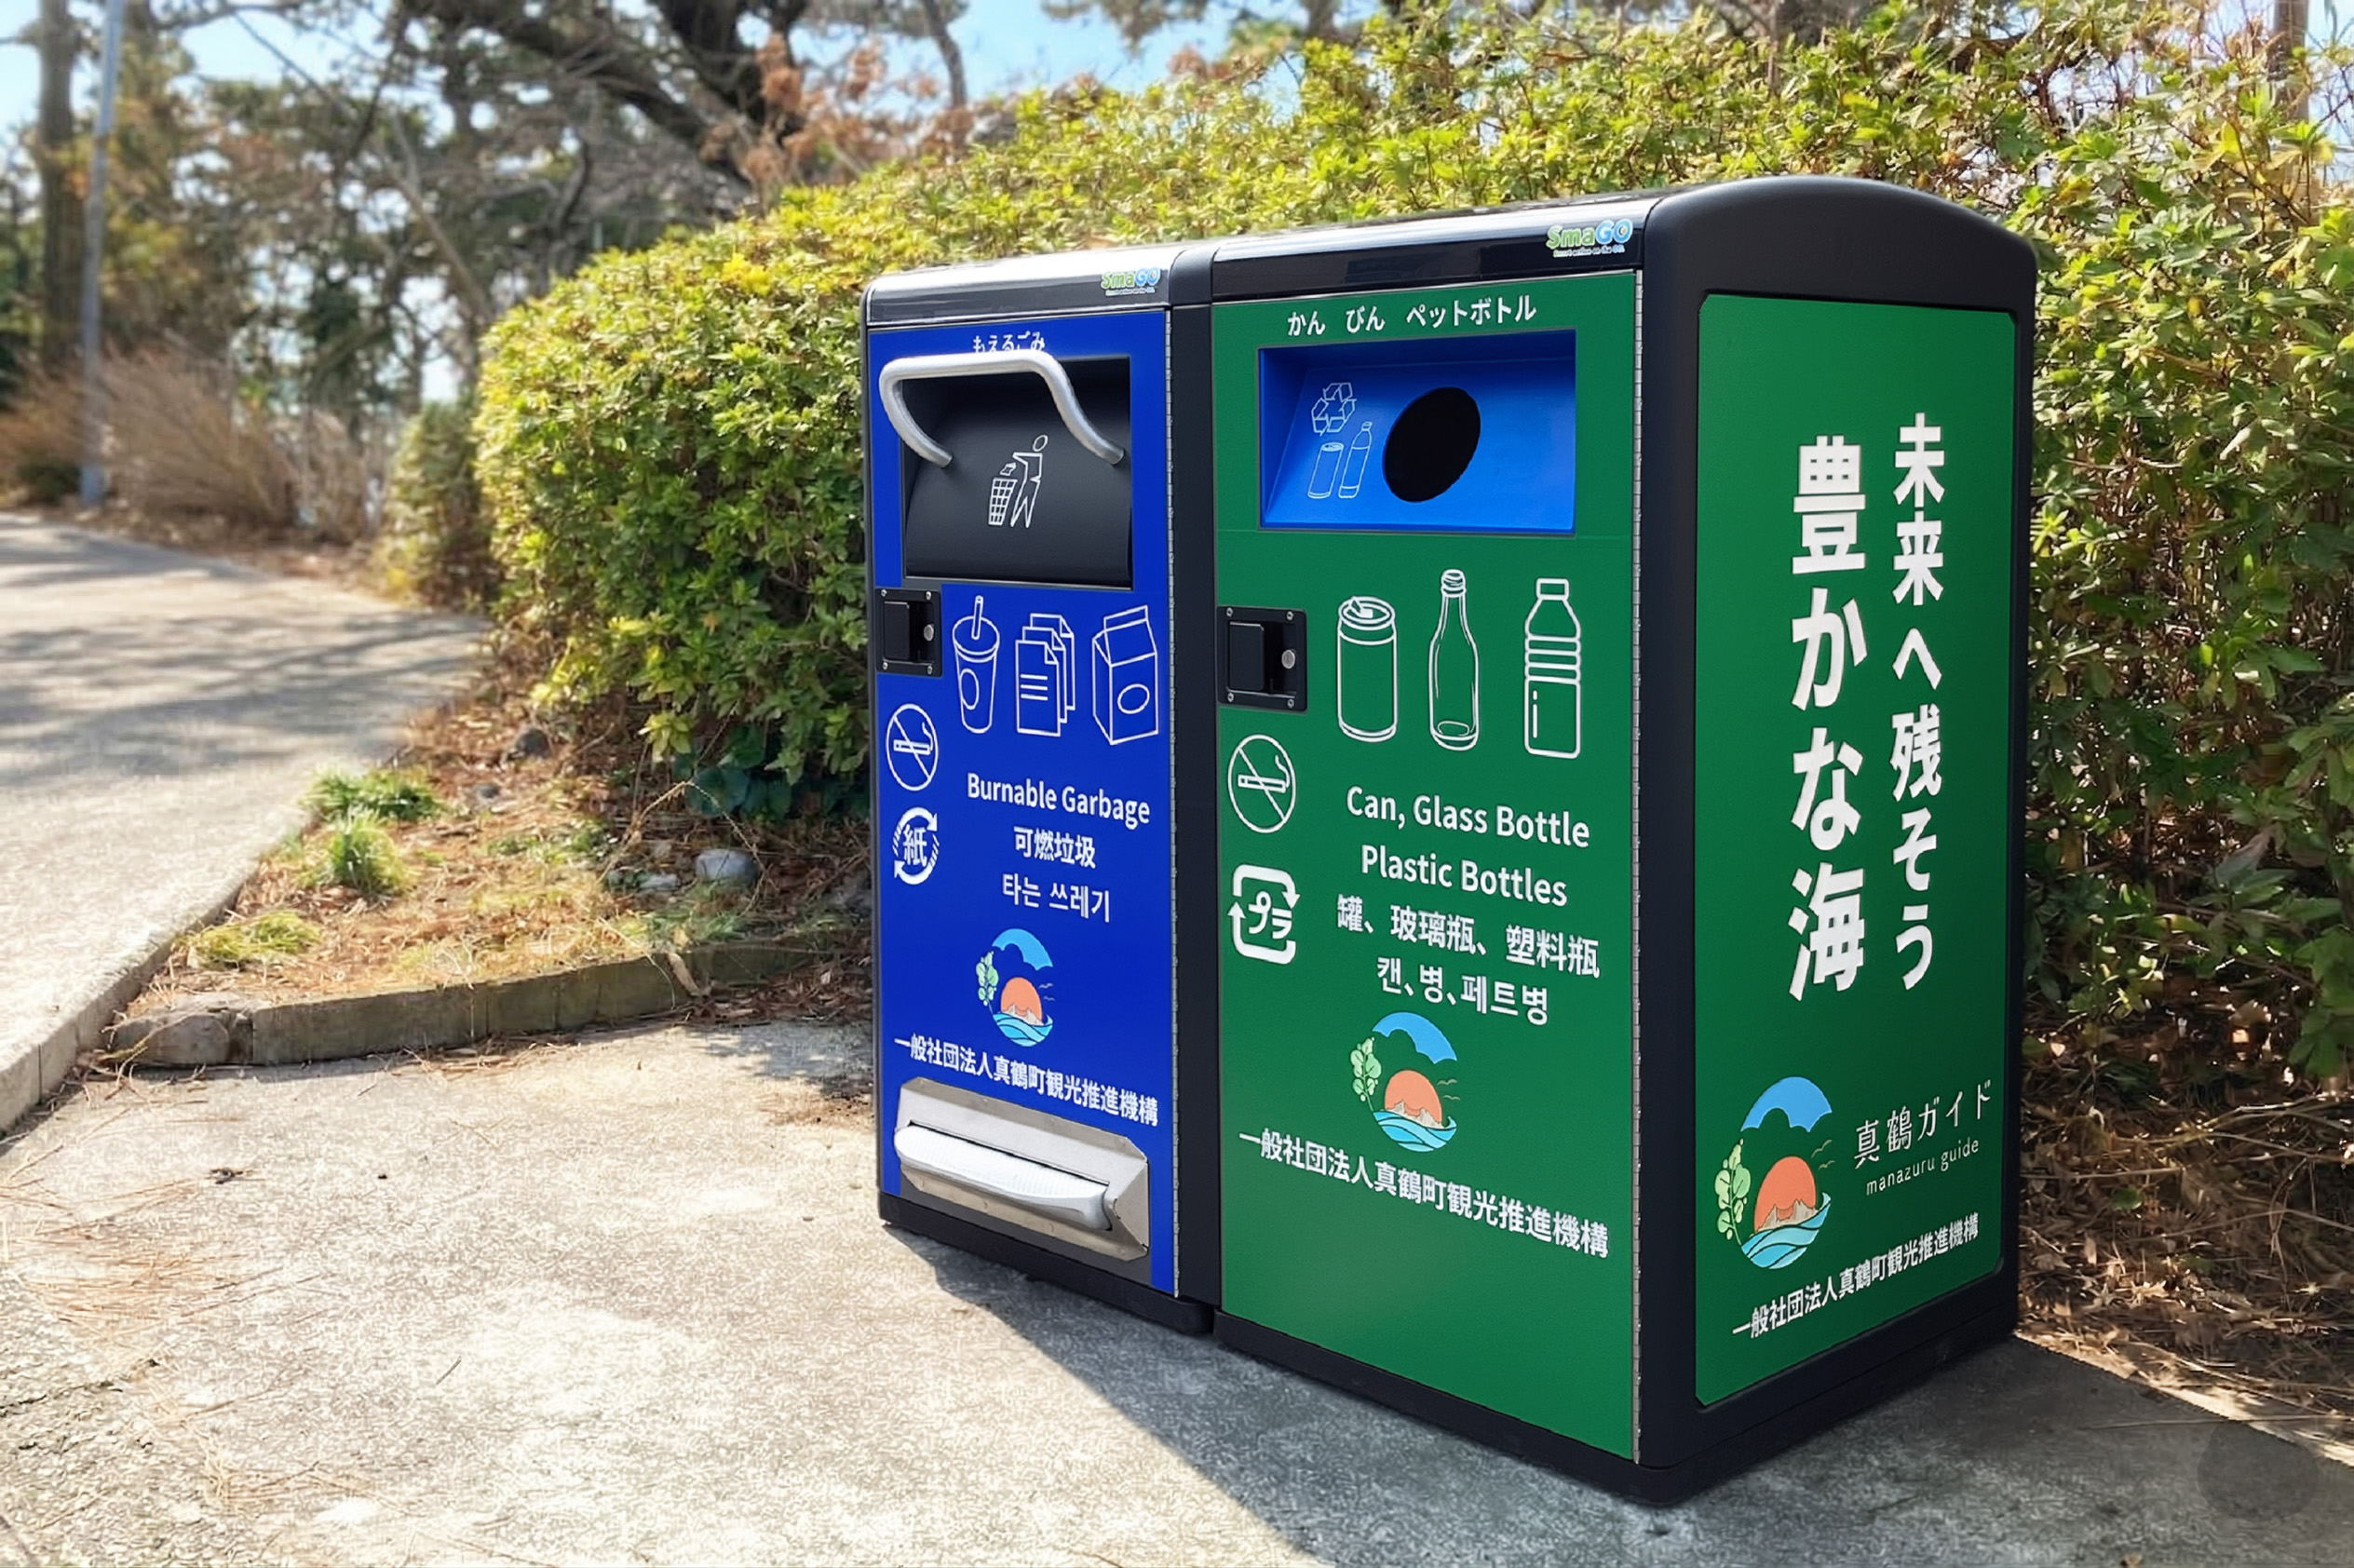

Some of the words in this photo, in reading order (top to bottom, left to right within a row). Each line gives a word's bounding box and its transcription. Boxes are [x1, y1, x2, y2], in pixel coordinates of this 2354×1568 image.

[1546, 218, 1633, 250] SmaGO
[1101, 267, 1161, 291] SmaGO
[1287, 310, 1326, 336] かん
[1346, 305, 1386, 333] びん
[1406, 294, 1537, 328] ペットボトル
[1788, 435, 1868, 1002] 豊かな海
[1889, 412, 1945, 991] 未来へ残そう
[967, 773, 1058, 810] Burnable
[1062, 786, 1150, 831] Garbage
[1346, 786, 1405, 830] Can,
[1413, 795, 1488, 834] Glass
[1496, 805, 1590, 848] Bottle
[1013, 826, 1096, 869] 可燃垃圾
[1361, 845, 1453, 888] Plastic
[1461, 859, 1567, 907] Bottles
[1003, 872, 1041, 908] 타는
[1048, 883, 1110, 923] 쓰레기
[894, 1033, 1158, 1127] 一般社団法人真鶴町観光推進機構
[1853, 1078, 1992, 1169] 真鶴ガイド
[1238, 1127, 1609, 1259] 一般社団法人真鶴町観光推進機構
[1865, 1156, 1935, 1196] manazuru
[1941, 1138, 1979, 1172] guide
[1731, 1211, 1979, 1339] 一般社団法人真鶴町観光推進機構
